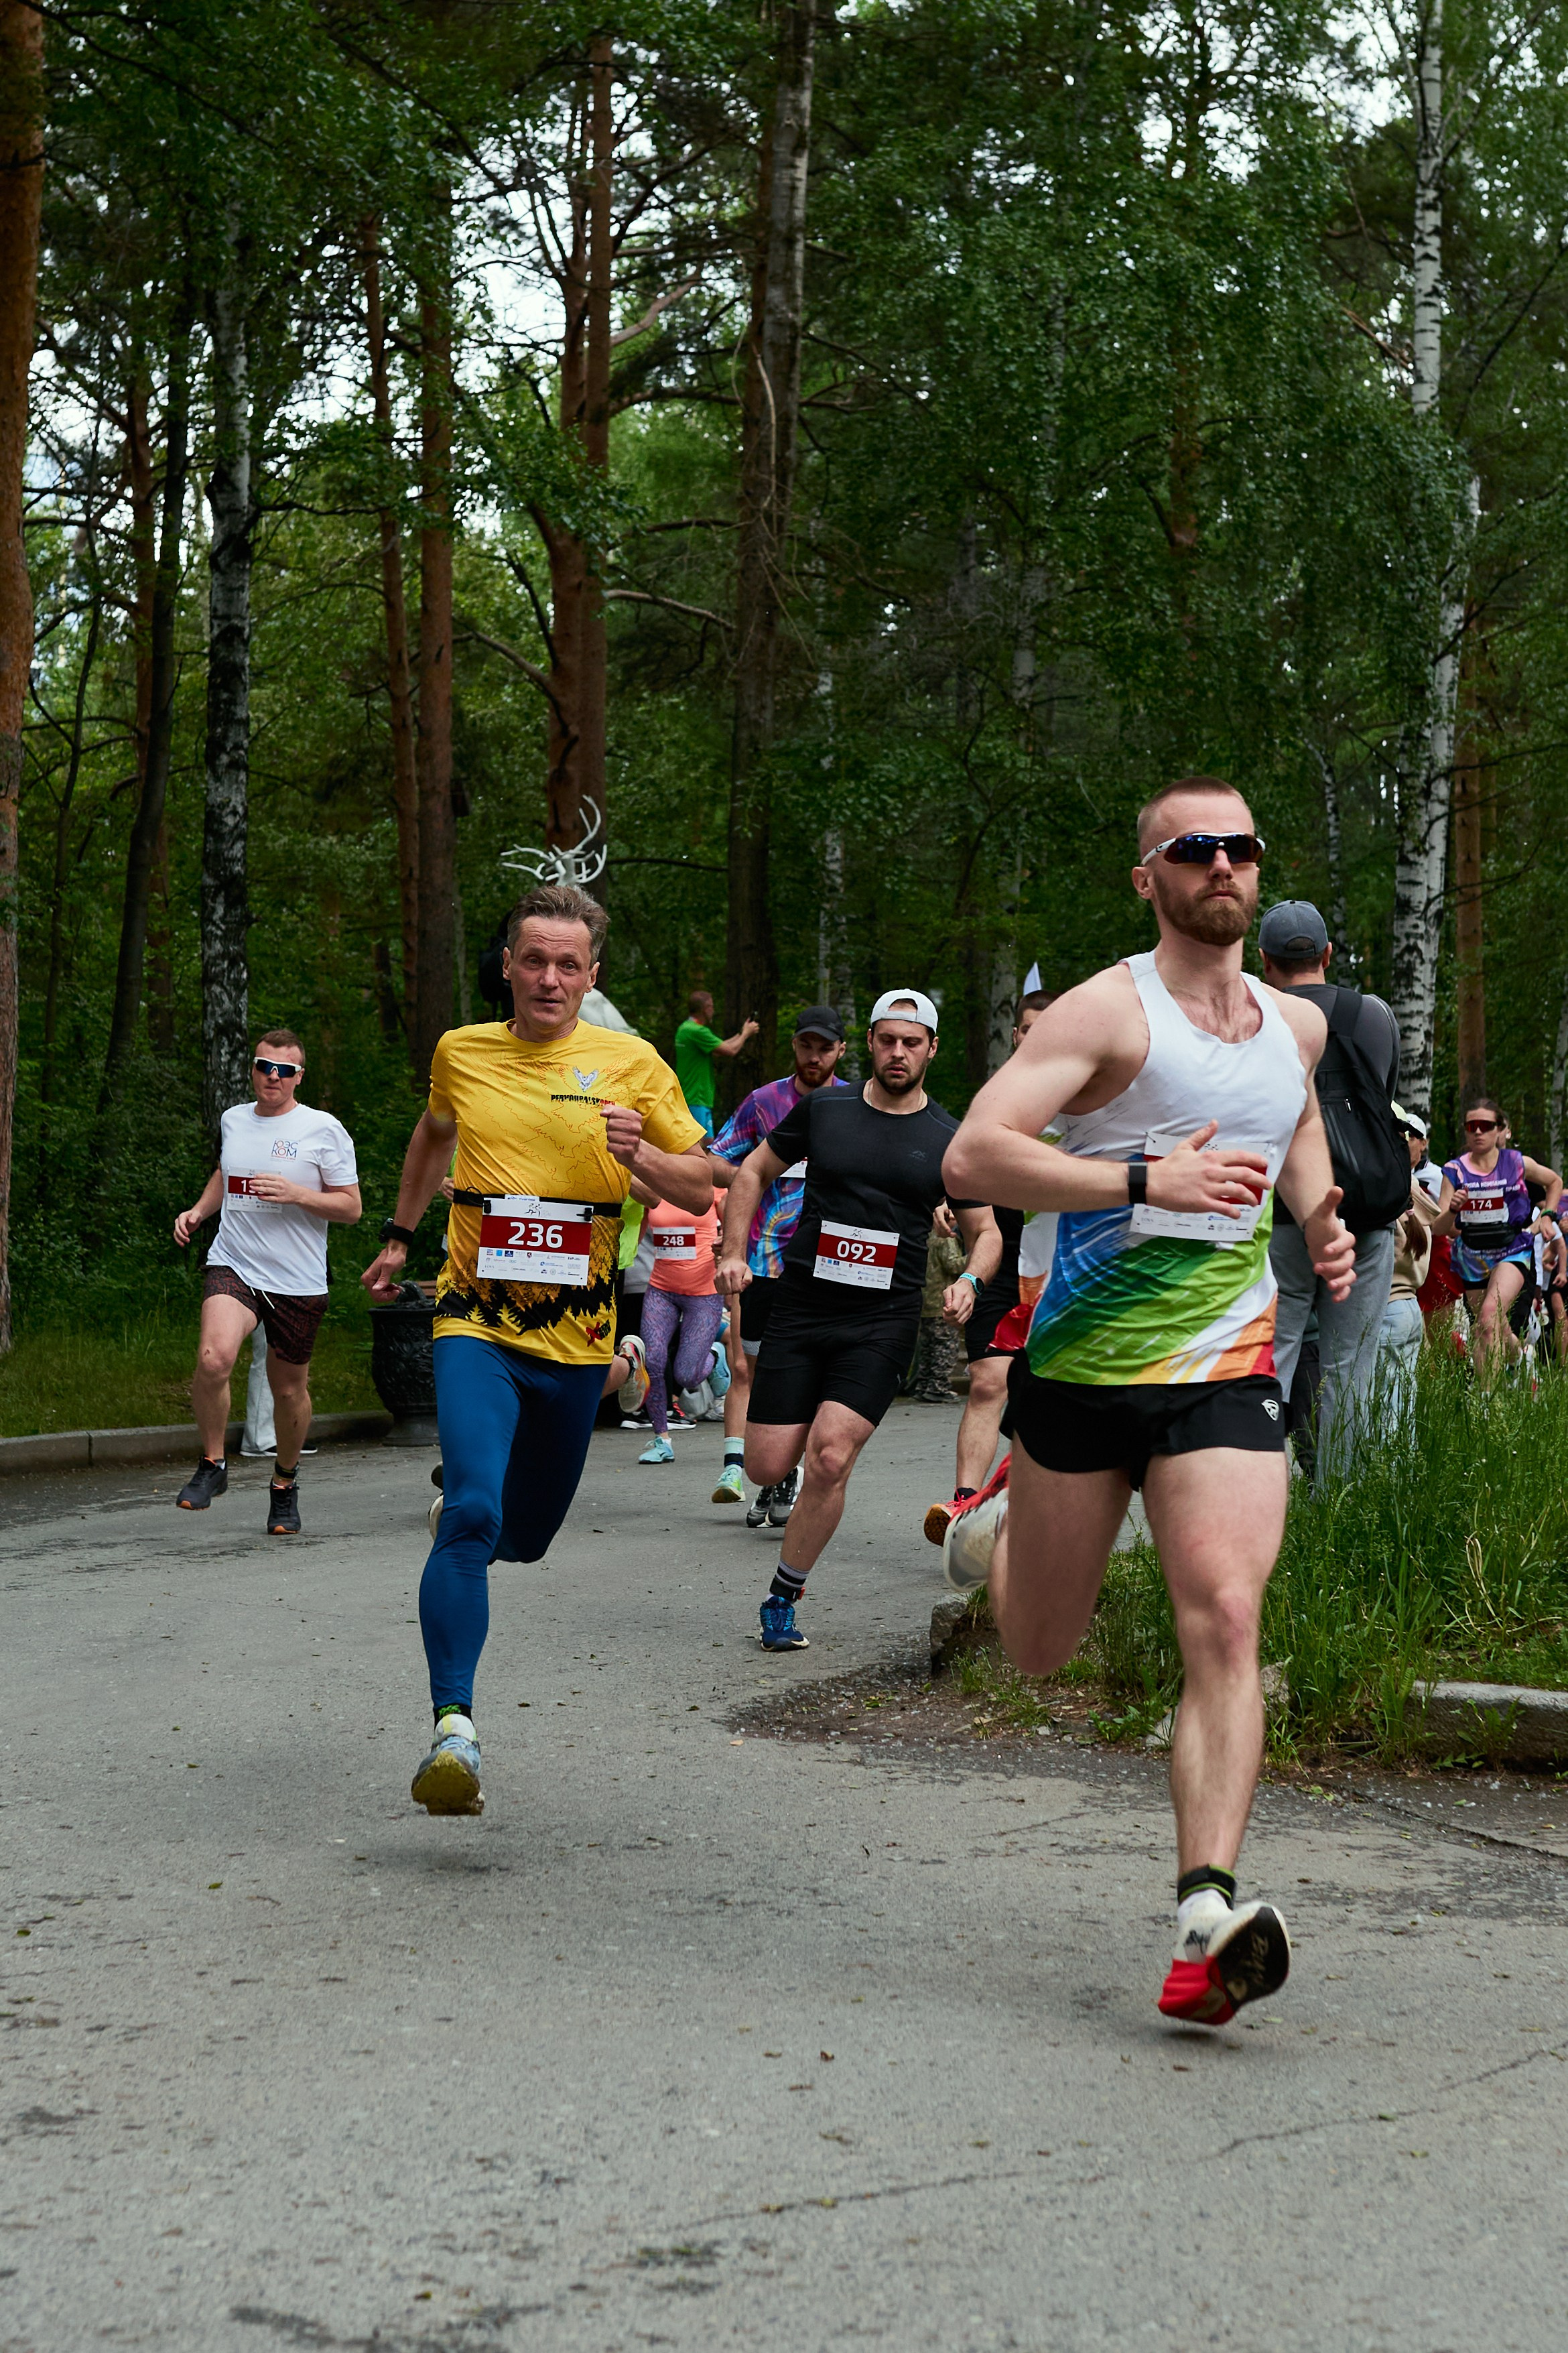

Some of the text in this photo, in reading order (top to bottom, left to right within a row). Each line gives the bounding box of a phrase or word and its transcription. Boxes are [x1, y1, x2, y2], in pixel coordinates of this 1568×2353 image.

[271, 1147, 297, 1158] КОМ
[1470, 1199, 1493, 1210] 174
[507, 1222, 564, 1249] 236
[663, 1236, 684, 1246] 248
[837, 1241, 876, 1263] 092
